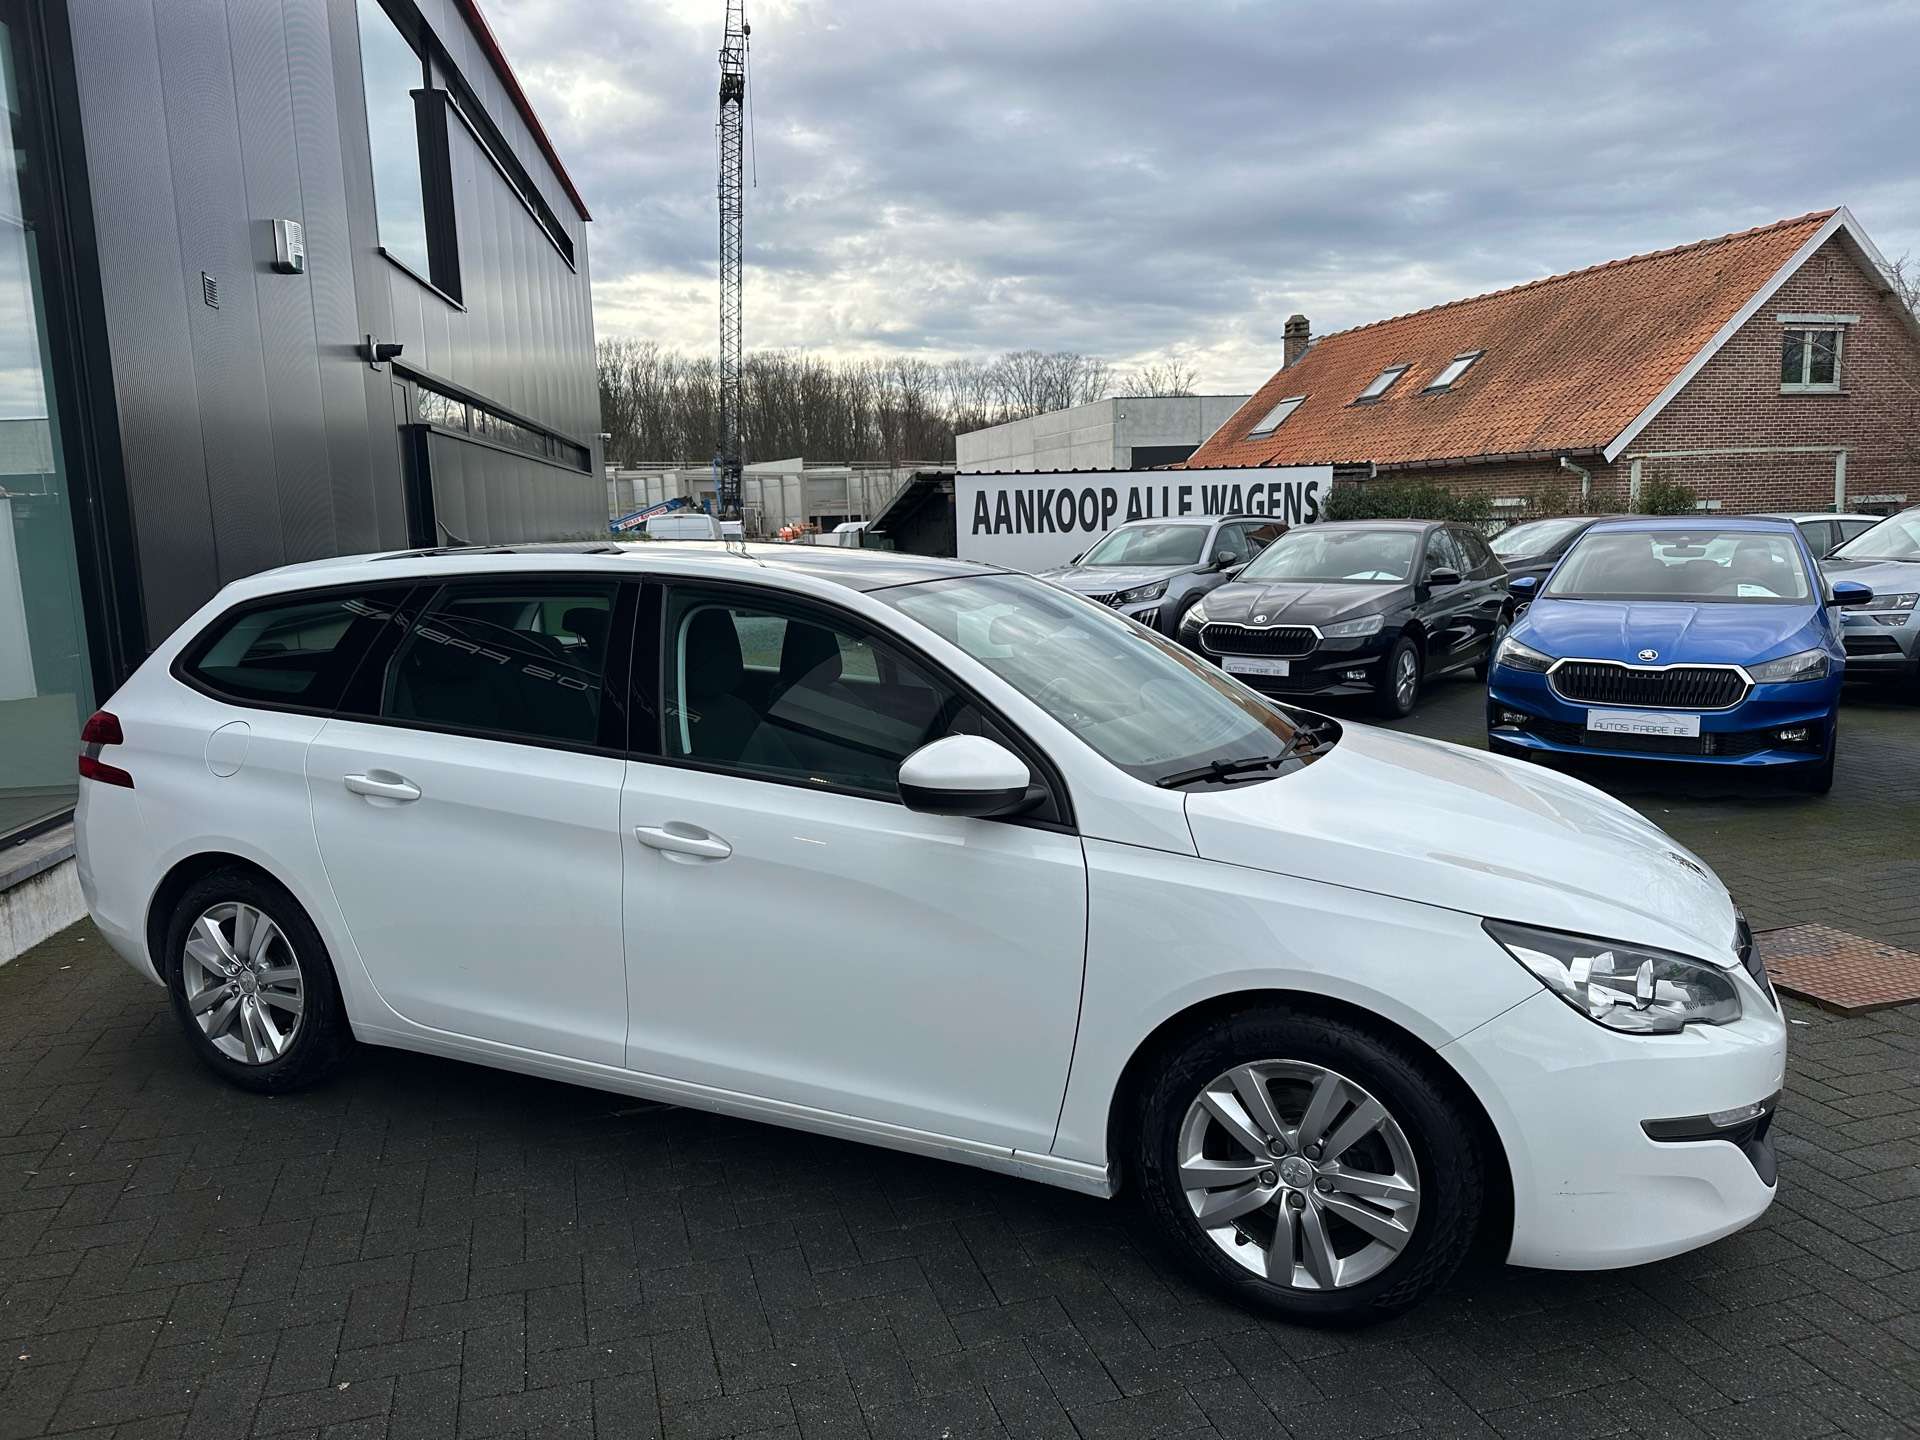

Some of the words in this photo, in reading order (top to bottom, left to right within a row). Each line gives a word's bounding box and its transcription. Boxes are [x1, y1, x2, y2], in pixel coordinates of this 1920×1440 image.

[972, 486, 1118, 536] AANKOOP
[1201, 481, 1319, 525] WAGENS
[1594, 722, 1630, 732] AUTOS
[1633, 724, 1669, 734] FABRE
